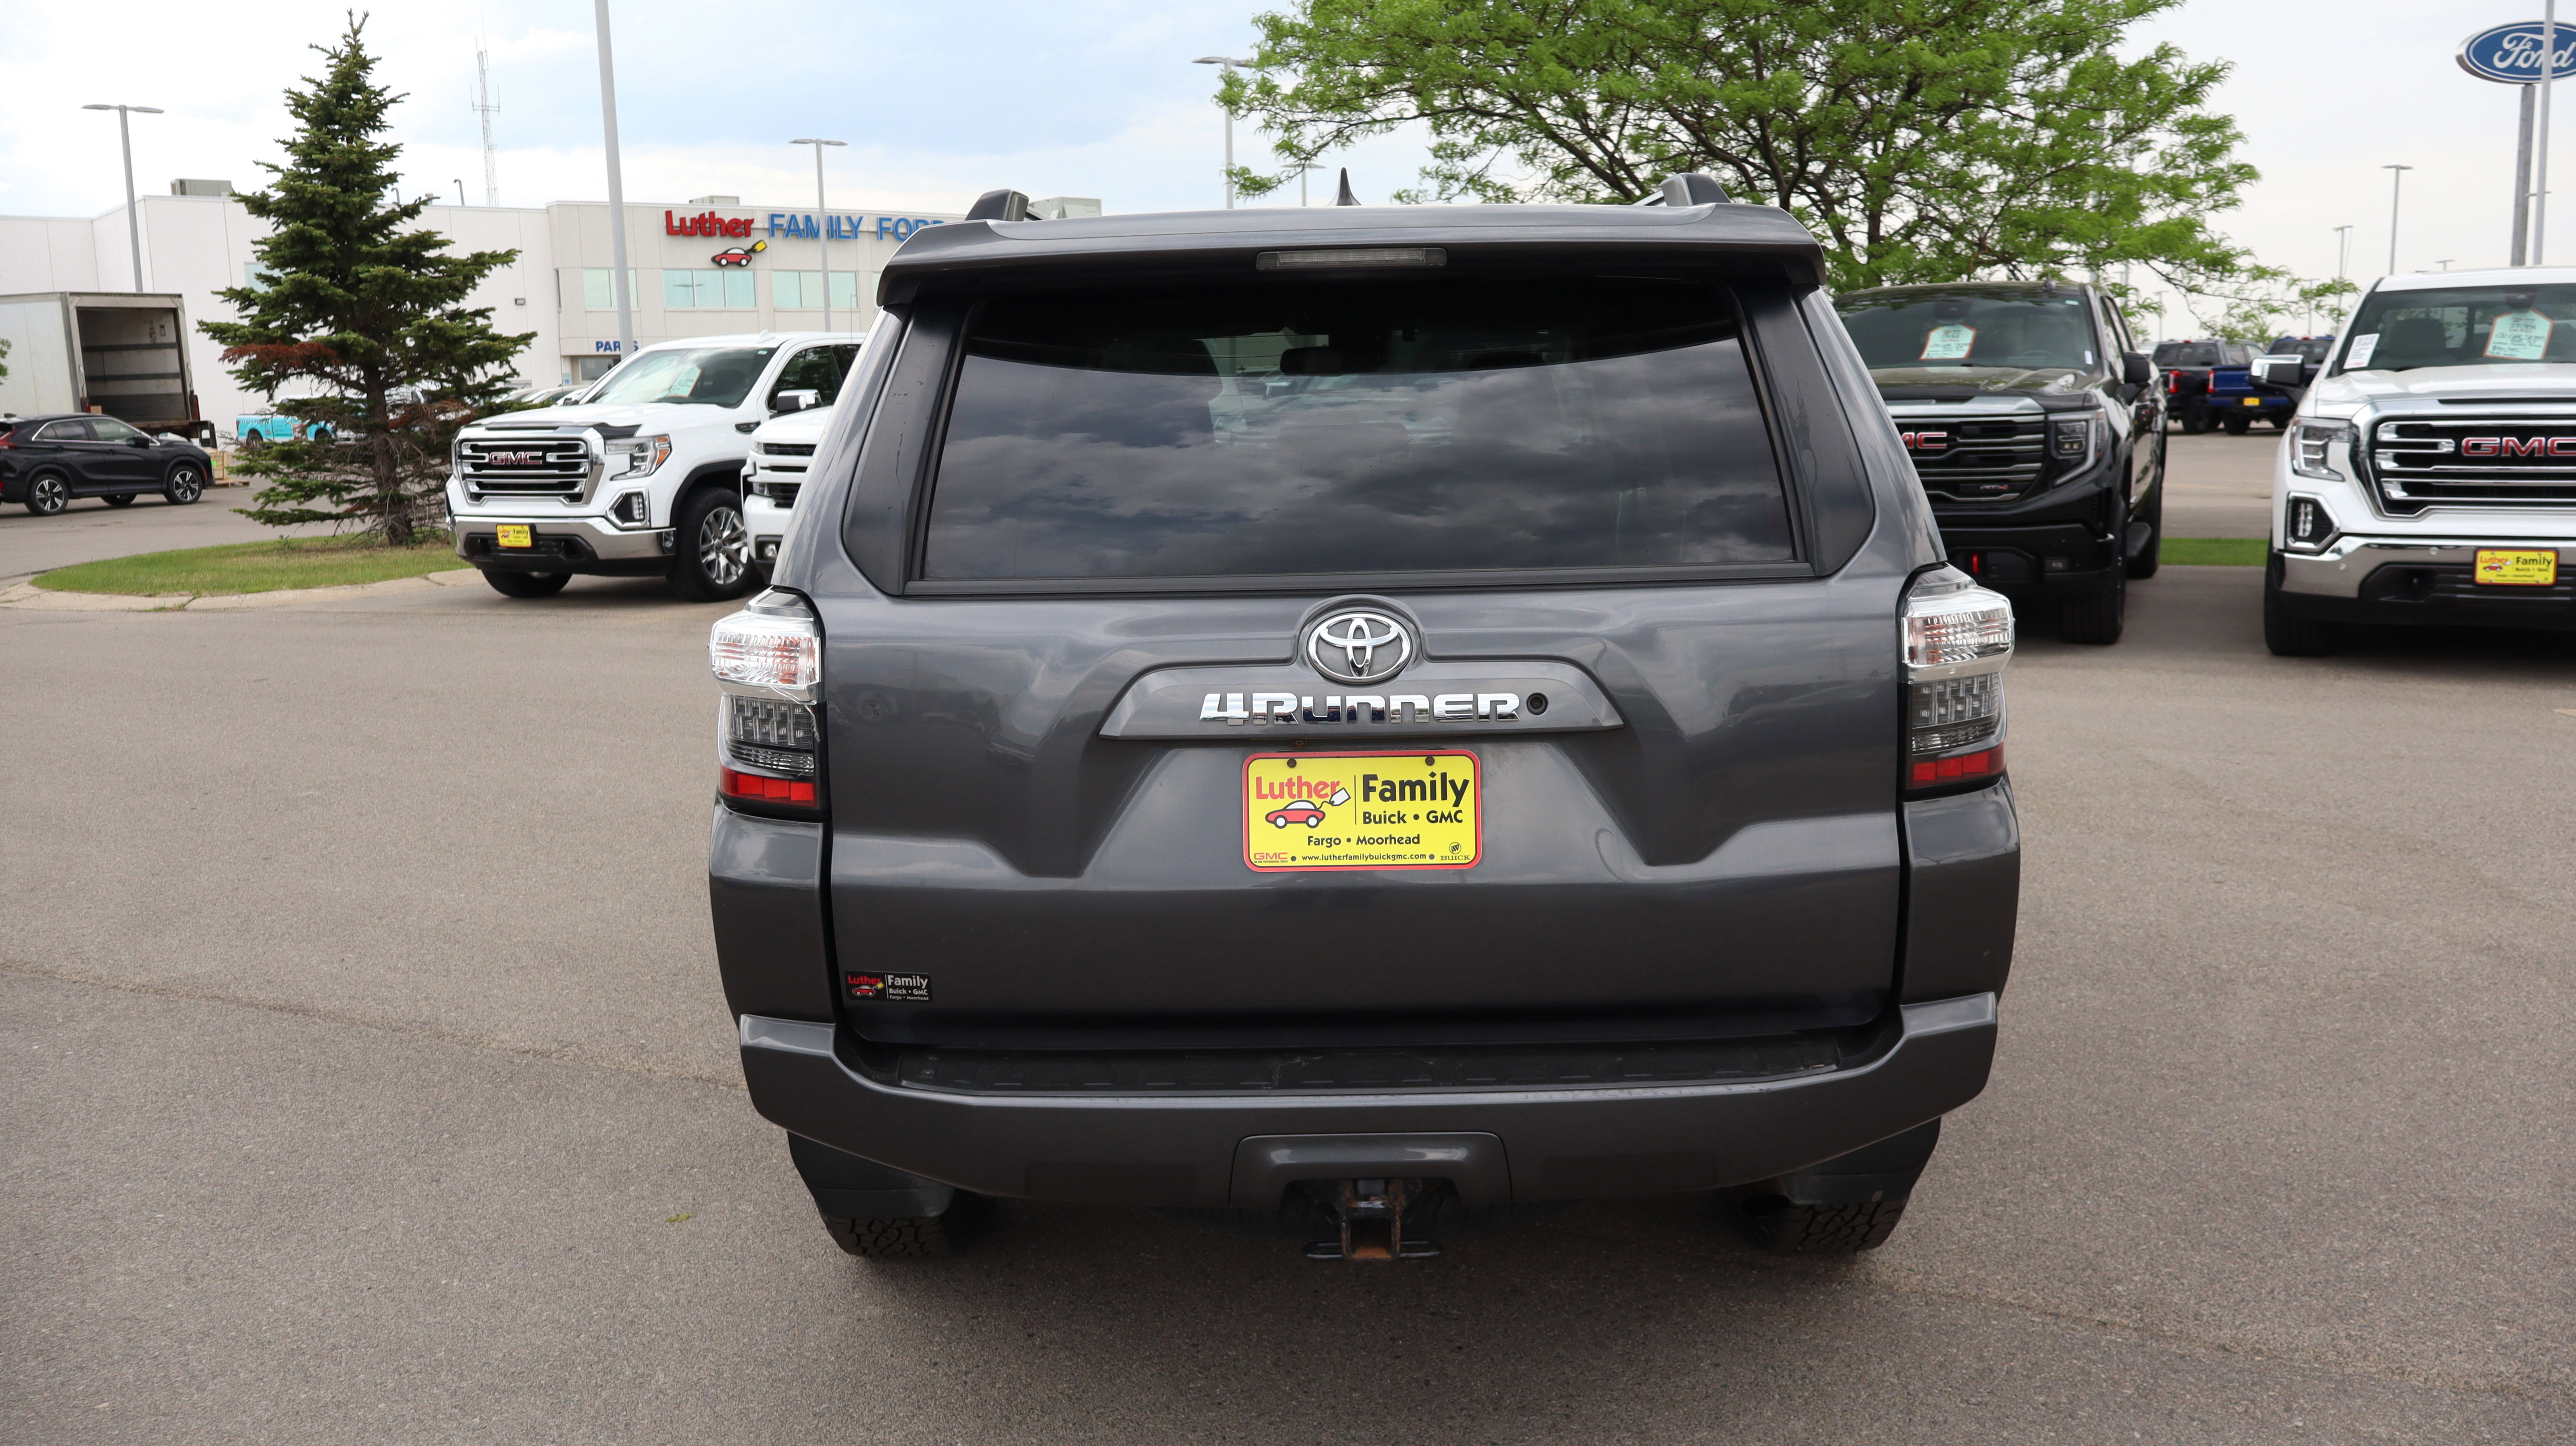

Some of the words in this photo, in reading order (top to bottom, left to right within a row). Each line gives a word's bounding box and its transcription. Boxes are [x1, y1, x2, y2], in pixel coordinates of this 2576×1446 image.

[2492, 32, 2576, 68] Ford
[665, 210, 755, 237] Luther
[768, 213, 864, 240] FAMILY
[877, 217, 945, 242] FO
[596, 341, 638, 352] PARS
[2461, 437, 2576, 457] GMC
[490, 451, 542, 465] GMC
[2516, 555, 2552, 567] Family
[1256, 776, 1340, 799] Luther
[1362, 771, 1470, 807] Family
[1363, 810, 1407, 824] Buick
[1426, 810, 1463, 823] GMC
[1308, 835, 1341, 848] Fargo
[1356, 834, 1420, 845] Moorhead
[1302, 852, 1426, 862] www.lutherfamilybuickgmc.com
[847, 975, 882, 984] Luther
[887, 975, 928, 988] Family
